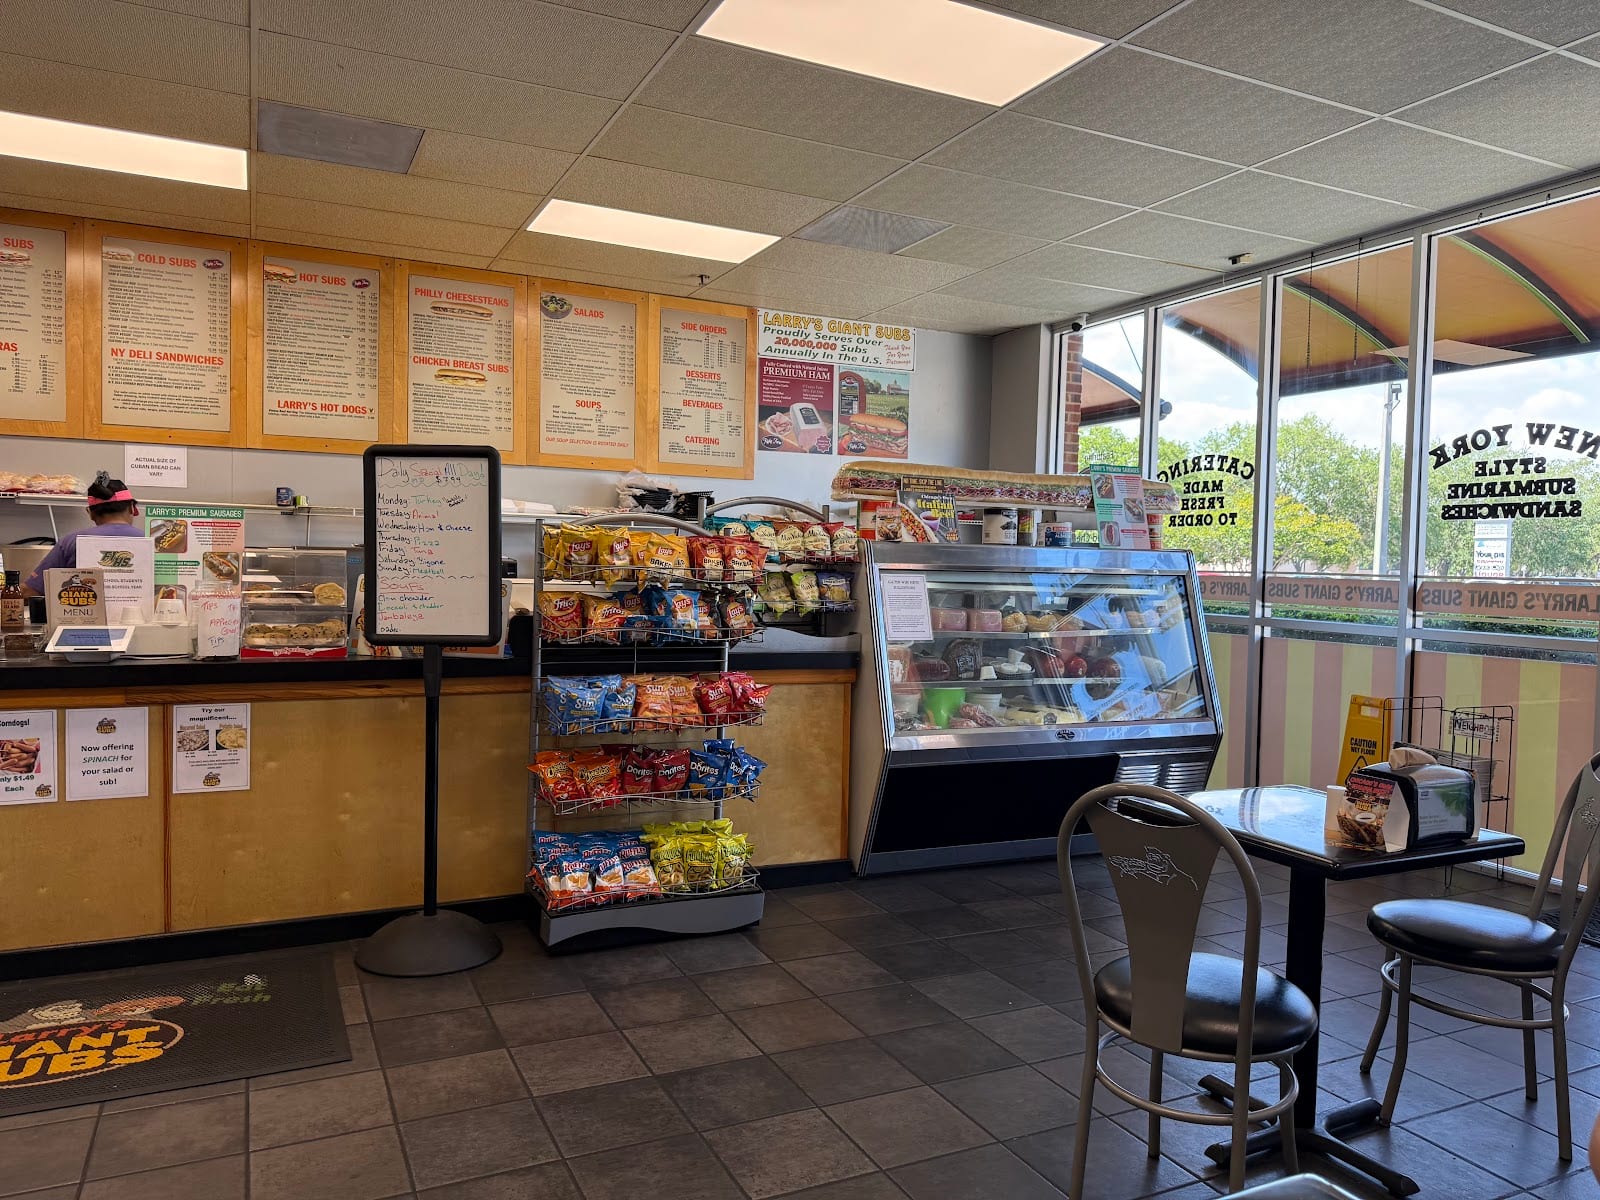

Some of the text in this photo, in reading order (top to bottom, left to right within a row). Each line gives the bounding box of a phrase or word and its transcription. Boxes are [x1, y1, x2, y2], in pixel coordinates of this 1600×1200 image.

[4, 237, 34, 249] SUBS
[138, 253, 166, 264] COLD
[169, 257, 197, 268] SUBS
[299, 273, 318, 283] HOT
[321, 276, 346, 286] SUBS
[415, 288, 509, 307] PHILLY CHEESESTEAKS
[574, 307, 605, 319] SALADS
[681, 322, 728, 335] SIDE ORDERS
[763, 312, 911, 341] LARRY'S GIANT SUBS
[763, 326, 883, 346] Proudly Serves Over
[774, 337, 868, 354] 20,000,000 Subs
[111, 347, 125, 357] NY
[129, 350, 152, 360] DELI
[155, 352, 224, 366] SANDWICHES
[764, 345, 822, 359] Annually
[838, 353, 858, 362] The
[862, 356, 882, 365] U.S.
[413, 355, 509, 373] CHICKEN BREAST SUBS
[686, 370, 721, 380] DESSERTS
[763, 367, 830, 380] PREMIUM HAM
[277, 400, 317, 411] LARRY'S
[321, 403, 339, 412] HOT
[342, 405, 367, 415] DOGS
[575, 399, 602, 409] SOUPS
[683, 399, 723, 410] BEVERAGES
[685, 436, 720, 445] CATERING
[377, 457, 410, 483] Daily
[444, 463, 457, 476] All
[148, 508, 242, 518] LARRY'S PREMIUM SAUSAGES
[650, 558, 672, 568] BAKED
[63, 608, 93, 616] MENU
[601, 607, 624, 618] Fritos
[646, 685, 664, 693] Sun
[708, 688, 724, 699] Sun
[575, 699, 595, 709] Sun
[81, 743, 134, 752] Now offering
[1350, 737, 1377, 749] CAUTION
[82, 755, 118, 763] SPINACH
[81, 767, 100, 776] your
[102, 766, 123, 774] salad
[626, 764, 654, 776] Doritos
[659, 764, 686, 777] Doritos
[690, 762, 719, 776] Doritos
[99, 778, 118, 786] sub!
[0, 1026, 161, 1060] IANT
[0, 1041, 164, 1082] UBS
